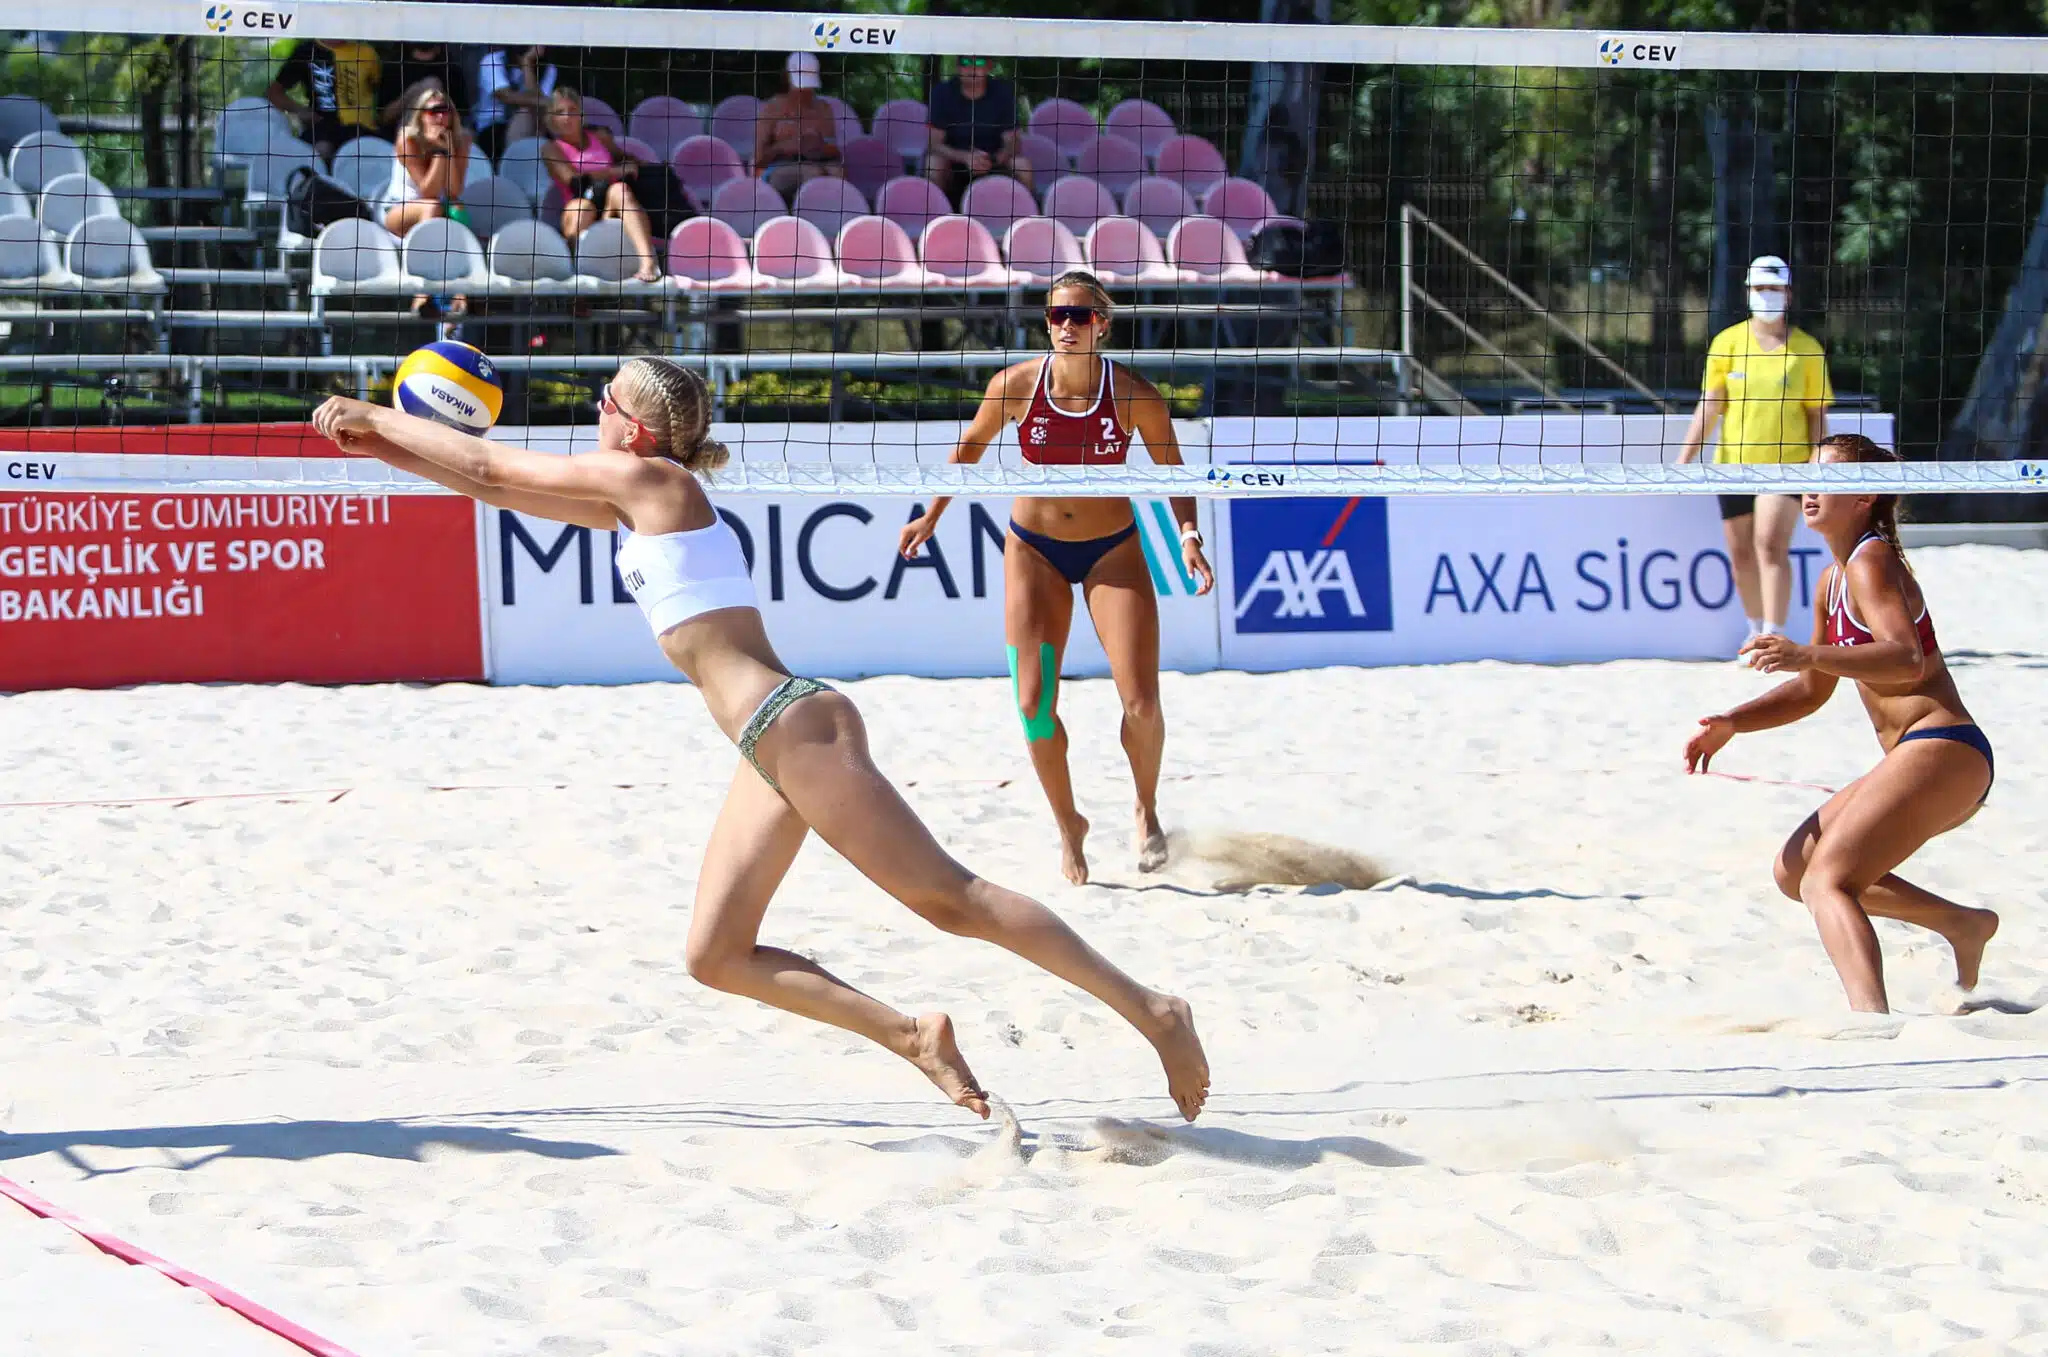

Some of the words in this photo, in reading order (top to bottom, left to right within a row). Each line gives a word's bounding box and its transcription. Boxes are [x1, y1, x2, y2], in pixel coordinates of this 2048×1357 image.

[243, 11, 292, 29] CEV
[849, 27, 896, 45] CEV
[1632, 44, 1677, 62] CEV
[1100, 417, 1116, 440] 2
[1094, 440, 1122, 455] LAT
[7, 462, 57, 480] CEV
[1241, 473, 1284, 486] CEV
[0, 495, 142, 534] TÜRKİYE
[0, 536, 160, 584] GENÇLİK
[168, 540, 217, 573] VE
[225, 537, 326, 571] SPOR
[1235, 549, 1367, 618] AXA
[1425, 551, 1556, 614] AXA
[0, 578, 204, 622] BAKANLIĞI
